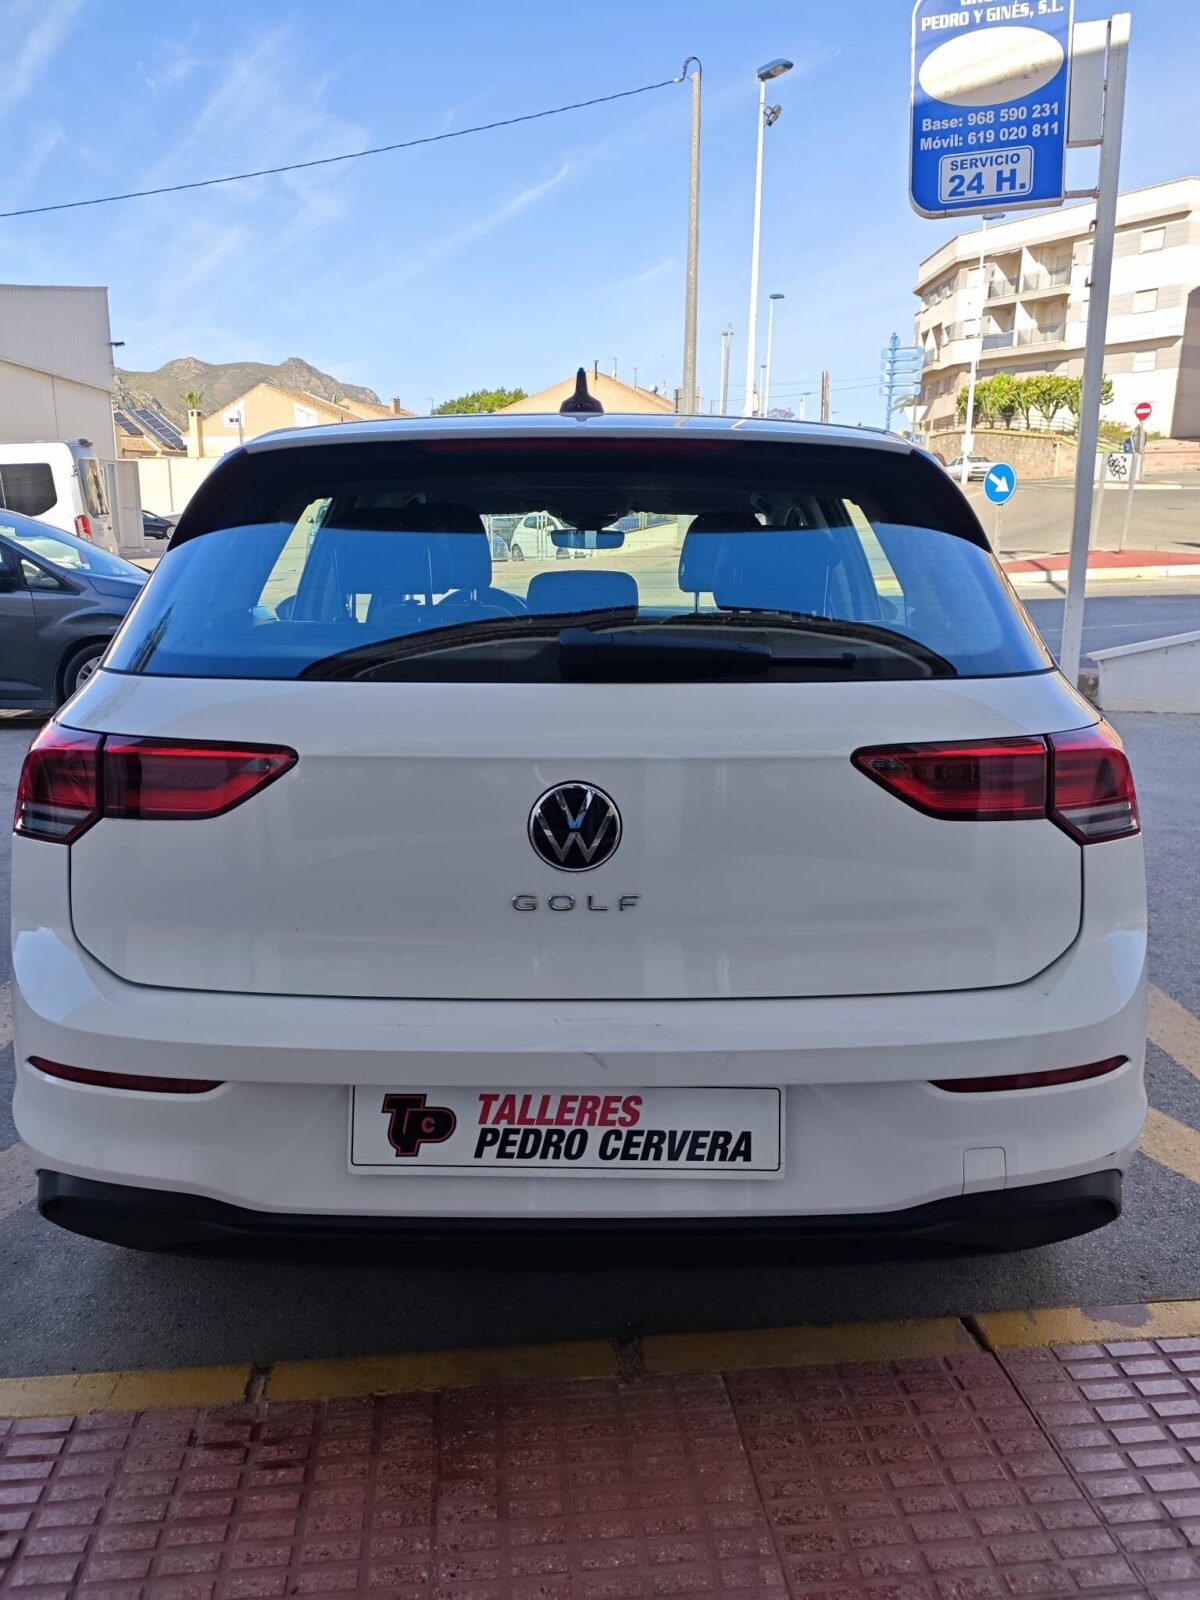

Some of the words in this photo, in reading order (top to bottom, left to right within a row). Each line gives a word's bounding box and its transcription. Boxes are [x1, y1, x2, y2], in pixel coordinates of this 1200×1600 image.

[921, 11, 969, 31] PEDRO
[973, 9, 983, 23] Y
[986, 1, 1034, 21] GINÉS,
[1038, 0, 1064, 14] S.L.
[922, 116, 963, 132] Base:
[967, 111, 995, 126] 968
[999, 107, 1027, 122] 590
[1031, 102, 1059, 119] 231
[920, 134, 963, 151] Móvil:
[967, 130, 995, 145] 619
[999, 126, 1027, 141] 020
[1031, 121, 1059, 138] 811
[950, 153, 1021, 171] SERVICIO
[948, 171, 985, 198] 24
[995, 168, 1027, 193] H.
[511, 894, 641, 912] GOLF
[478, 1093, 643, 1127] TALLERES
[473, 1128, 588, 1160] PEDRO
[598, 1130, 753, 1162] CERVERA
